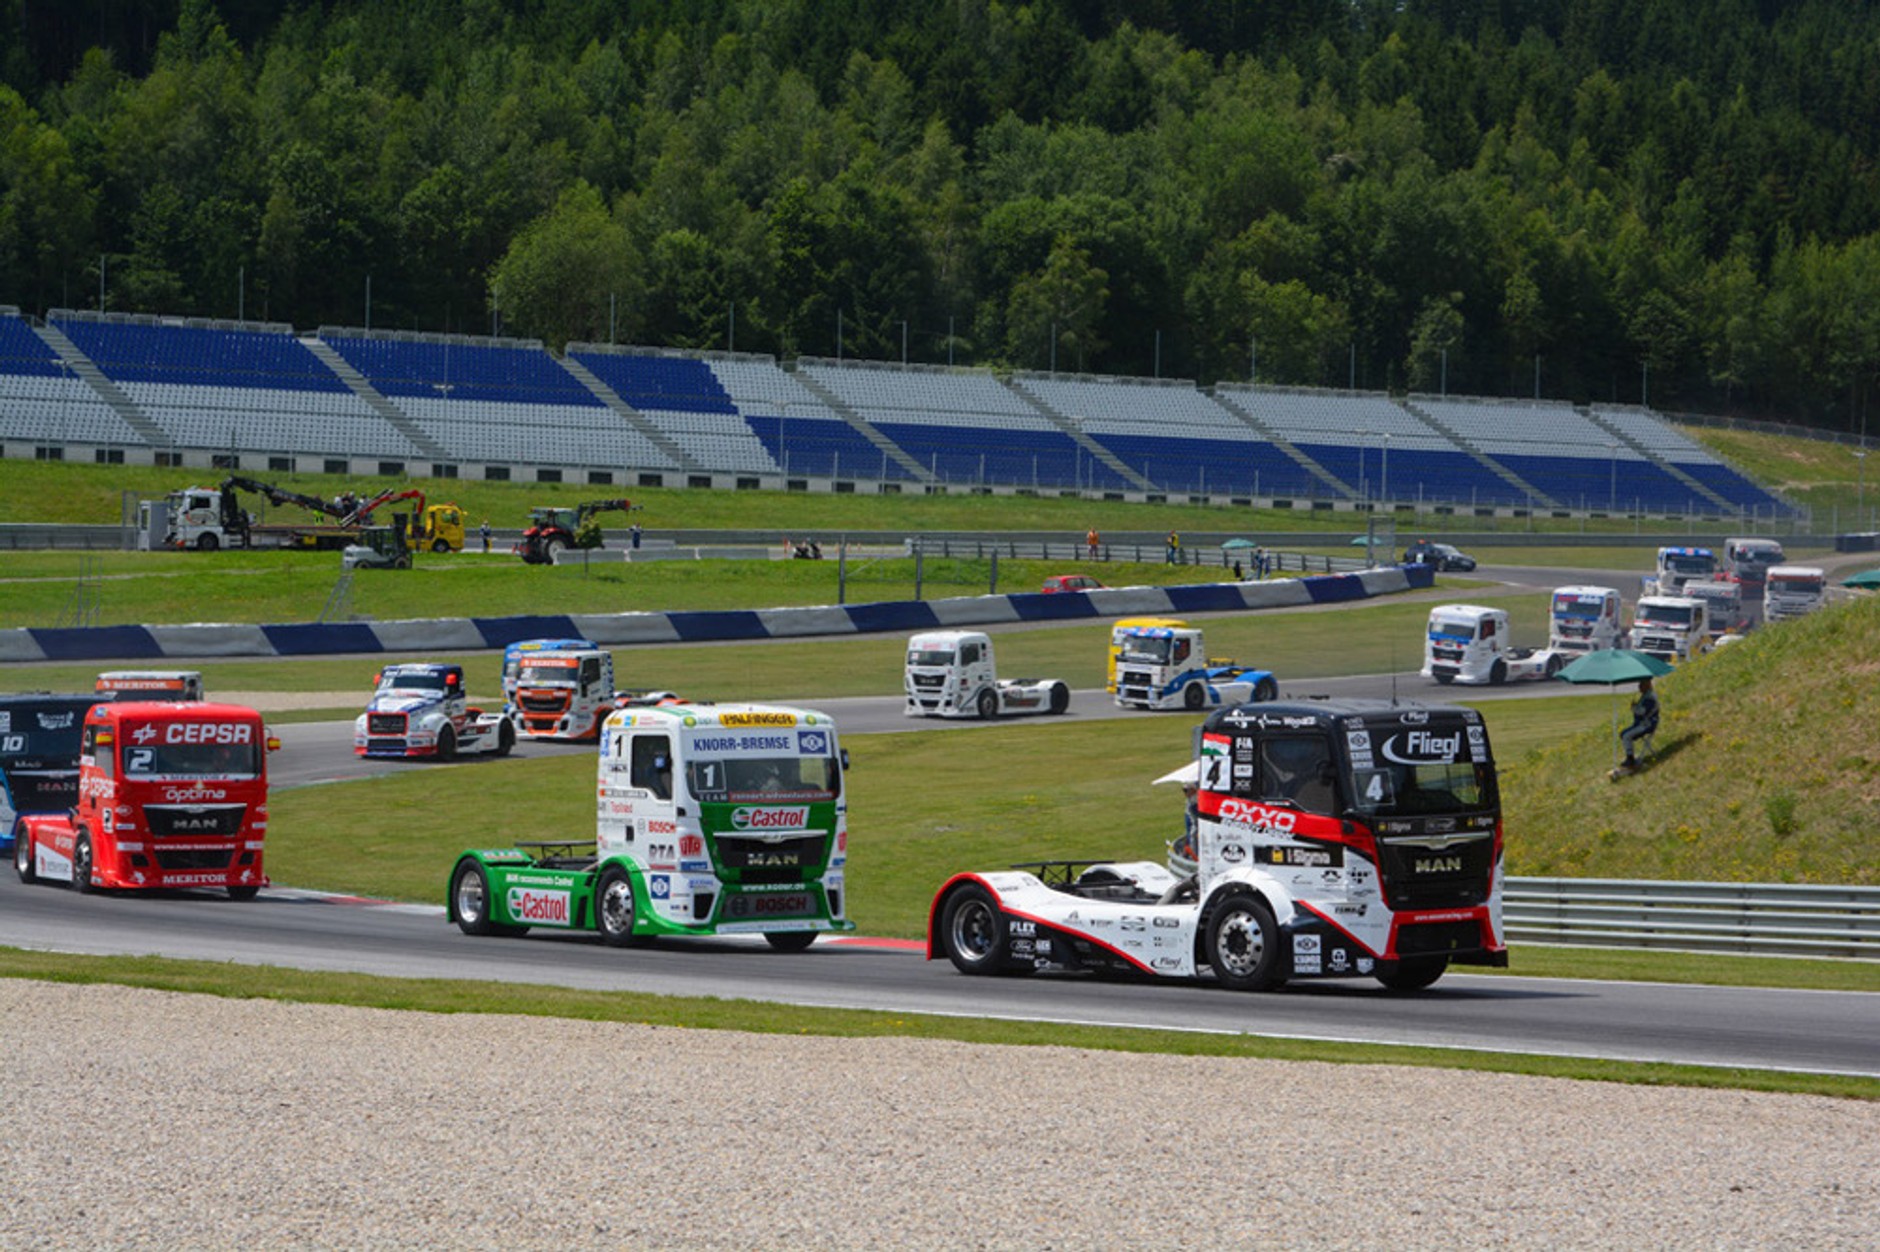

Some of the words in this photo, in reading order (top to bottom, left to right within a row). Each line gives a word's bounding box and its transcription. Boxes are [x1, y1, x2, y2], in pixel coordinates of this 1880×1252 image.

[165, 723, 252, 744] CEPSA
[2, 736, 24, 752] 10
[615, 734, 622, 757] 1
[693, 736, 791, 751] KNORR-BREMSE
[1407, 731, 1460, 760] Fliegl
[129, 749, 153, 772] 2
[703, 764, 715, 788] 1
[1206, 756, 1221, 789] 4
[165, 787, 226, 803] optima
[1365, 774, 1383, 801] 4
[172, 818, 218, 829] MAN
[751, 808, 805, 827] Castrol
[1218, 799, 1296, 832] OXXO
[648, 820, 676, 834] BOSCH
[747, 853, 799, 866] MAN
[1415, 856, 1462, 873] MAN
[163, 874, 227, 884] MERITOR
[523, 892, 568, 922] Castrol
[755, 896, 807, 912] BOSCH
[1009, 921, 1036, 934] FLEX
